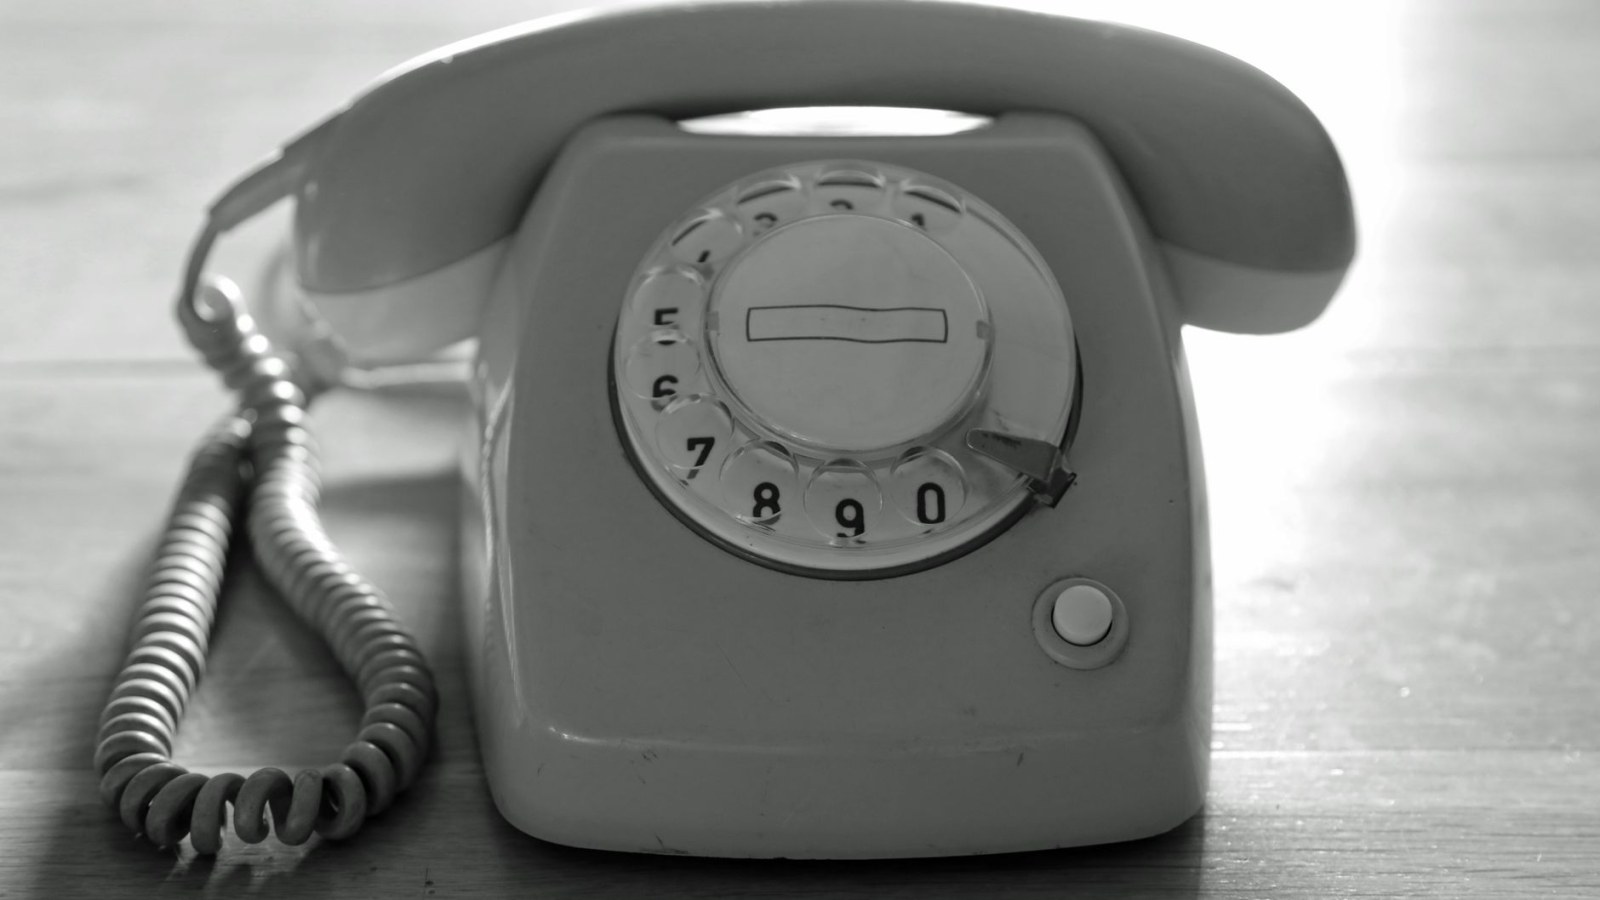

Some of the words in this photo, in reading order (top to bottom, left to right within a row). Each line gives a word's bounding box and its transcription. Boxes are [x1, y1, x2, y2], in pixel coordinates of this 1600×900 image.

[653, 307, 680, 345] 5
[651, 375, 679, 411] 6
[686, 437, 716, 480] 7
[752, 481, 782, 525] 8
[834, 498, 867, 543] 9
[917, 481, 946, 525] 0
